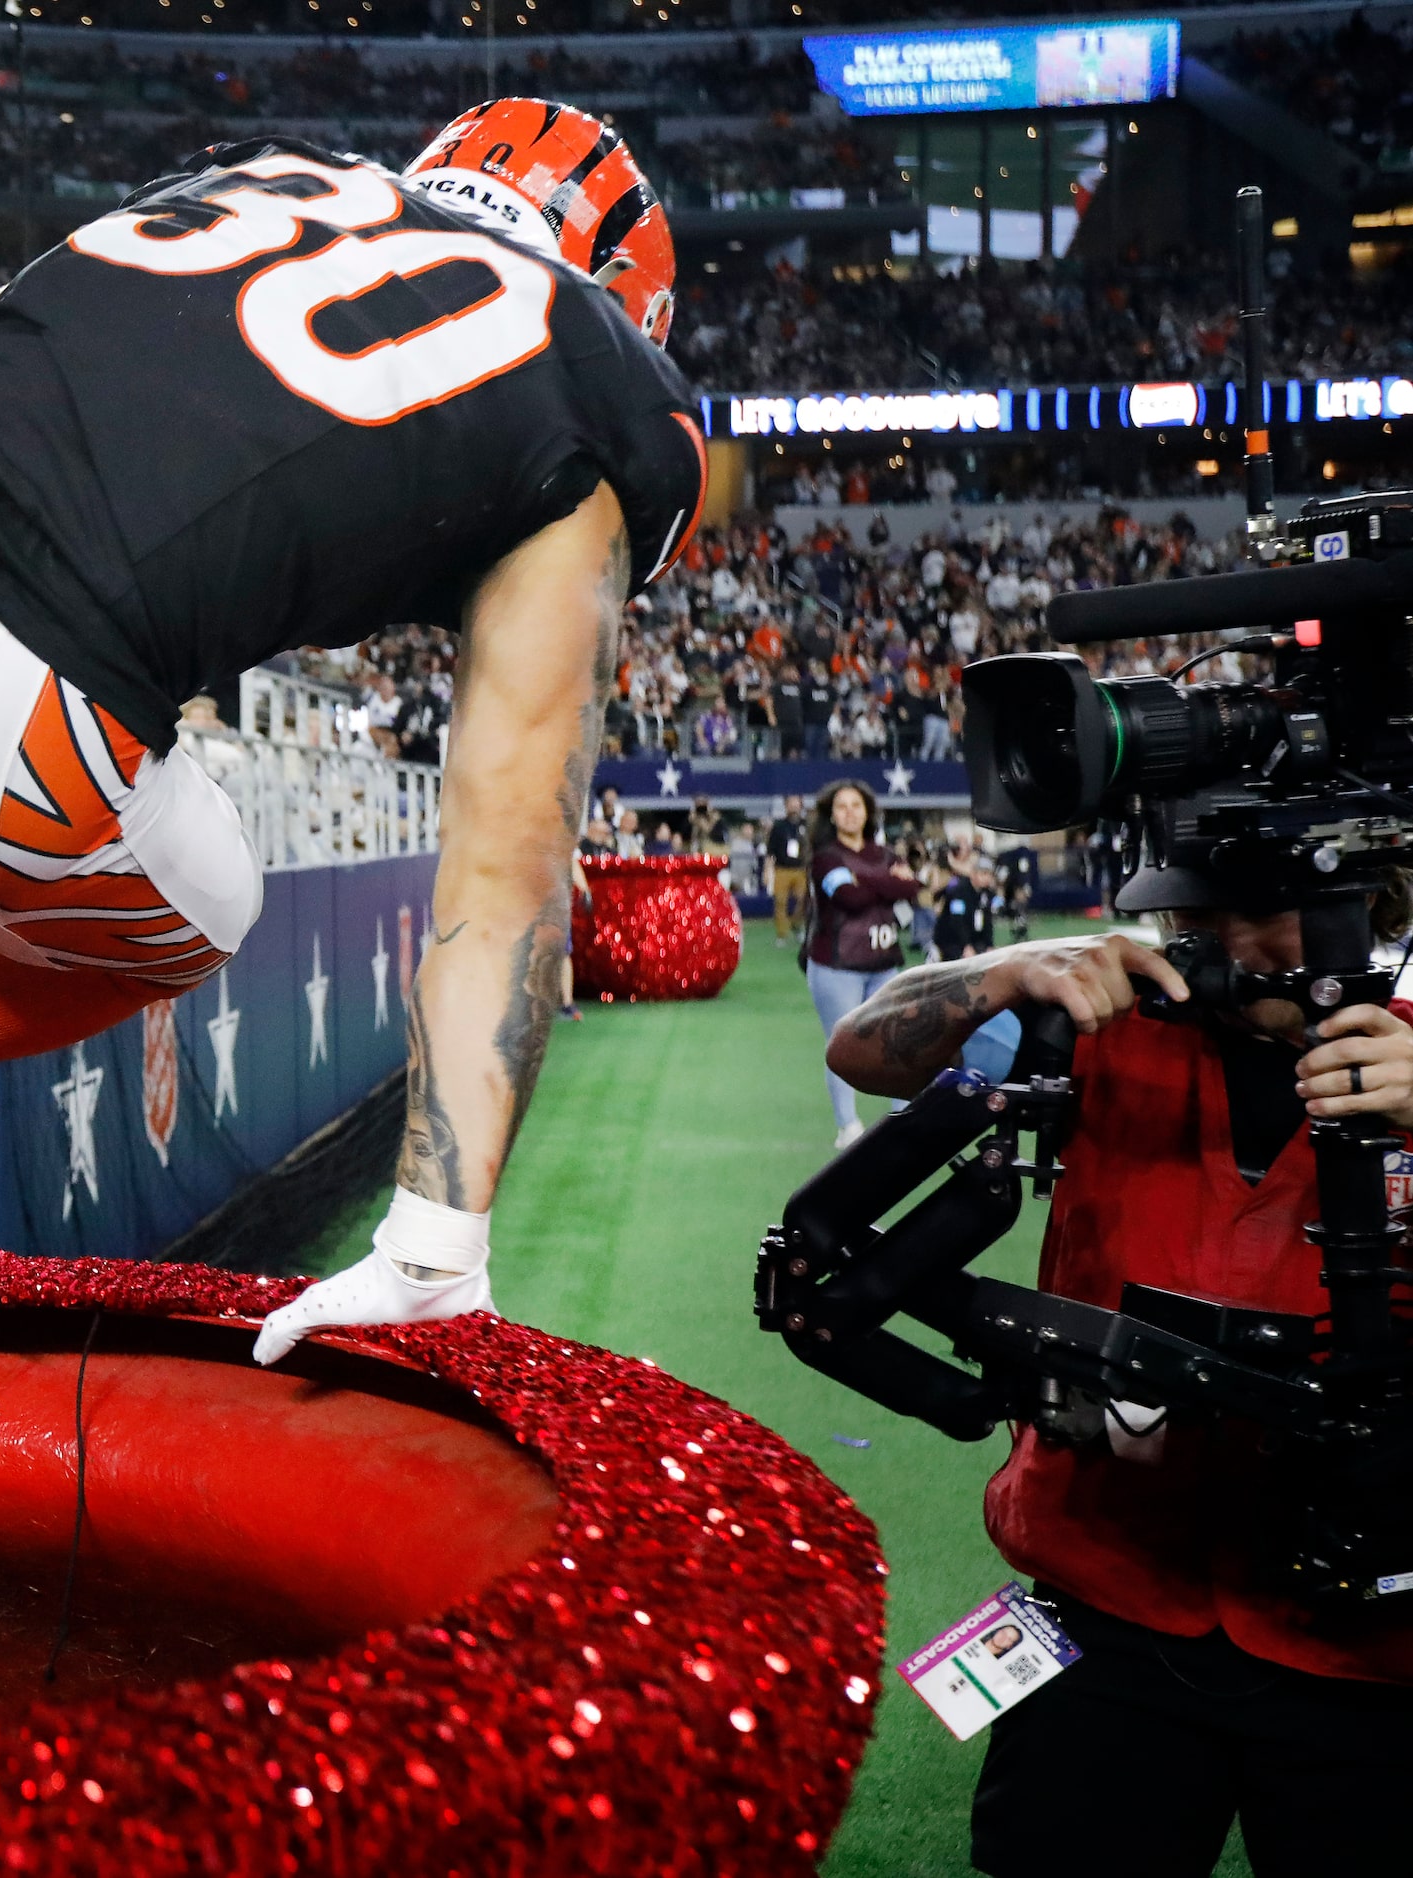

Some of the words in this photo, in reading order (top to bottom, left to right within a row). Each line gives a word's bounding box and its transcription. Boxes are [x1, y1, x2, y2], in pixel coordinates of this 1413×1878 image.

[67, 153, 557, 427] 30
[907, 1600, 1002, 1675] BROADCAST
[1007, 1600, 1061, 1657] SEASON
